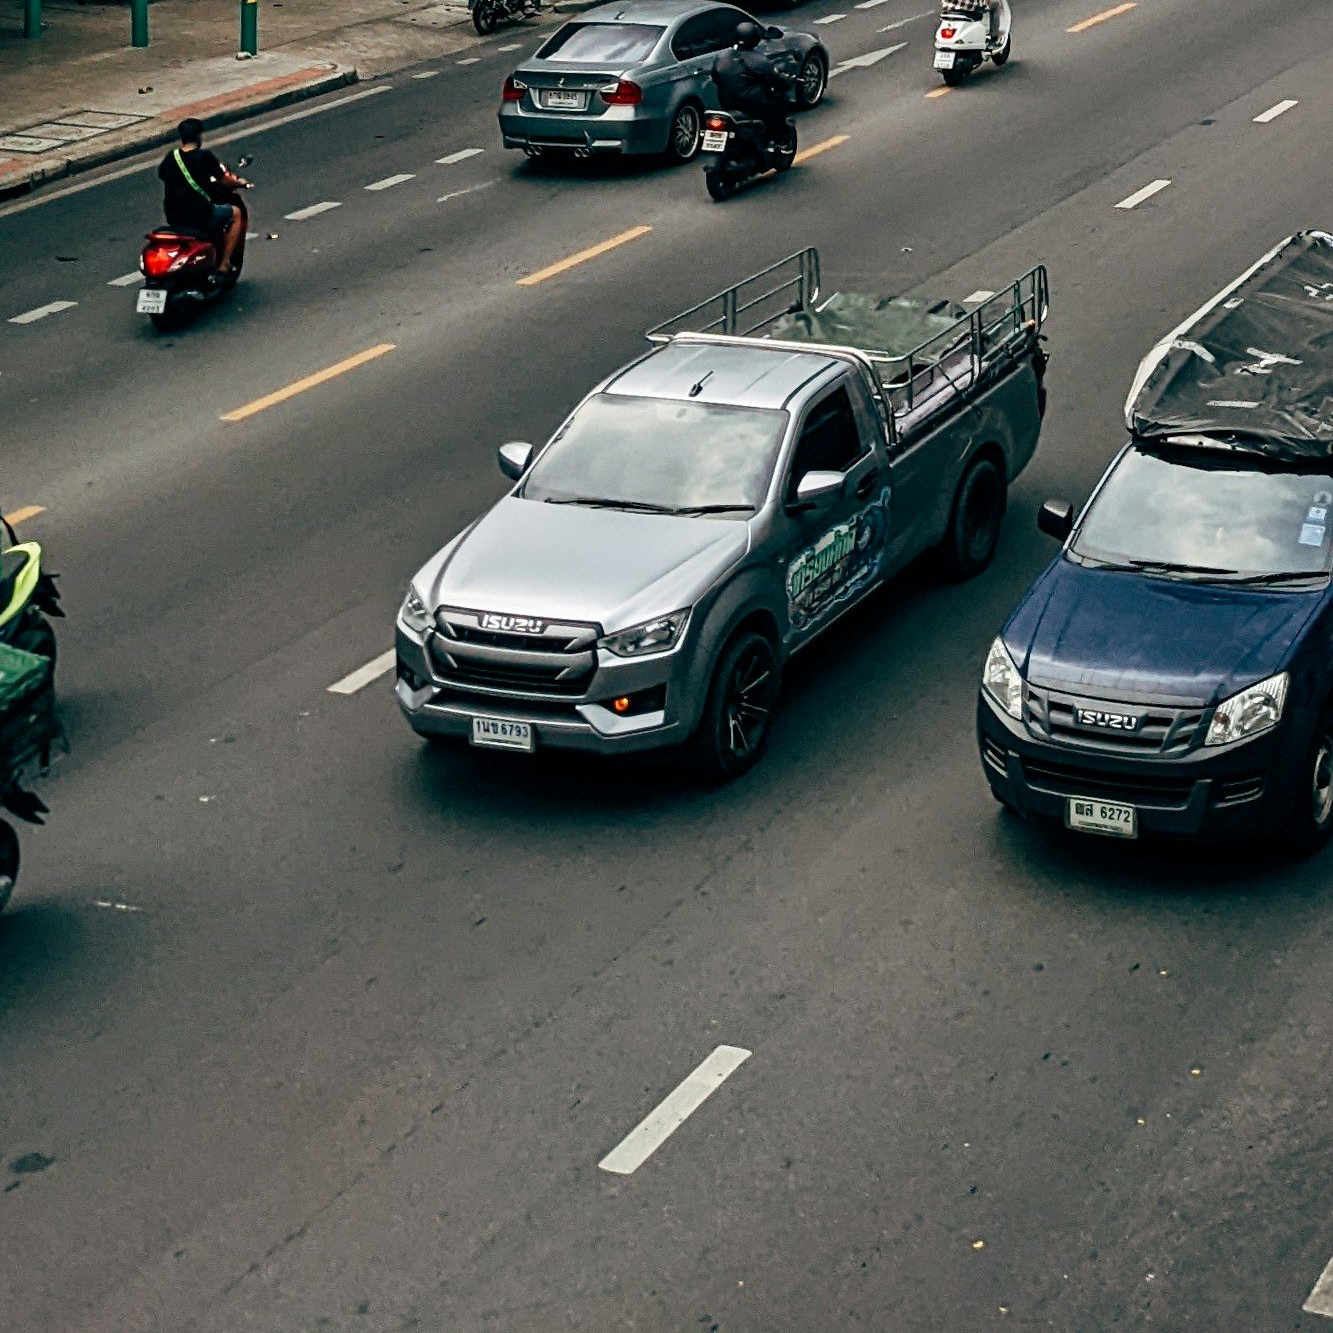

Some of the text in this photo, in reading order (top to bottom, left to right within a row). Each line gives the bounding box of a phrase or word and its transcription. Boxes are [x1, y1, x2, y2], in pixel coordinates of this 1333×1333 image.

[481, 613, 543, 633] ISUZU
[1077, 709, 1138, 730] ISUZU
[501, 723, 529, 738] 6793
[1100, 806, 1131, 823] 6272
